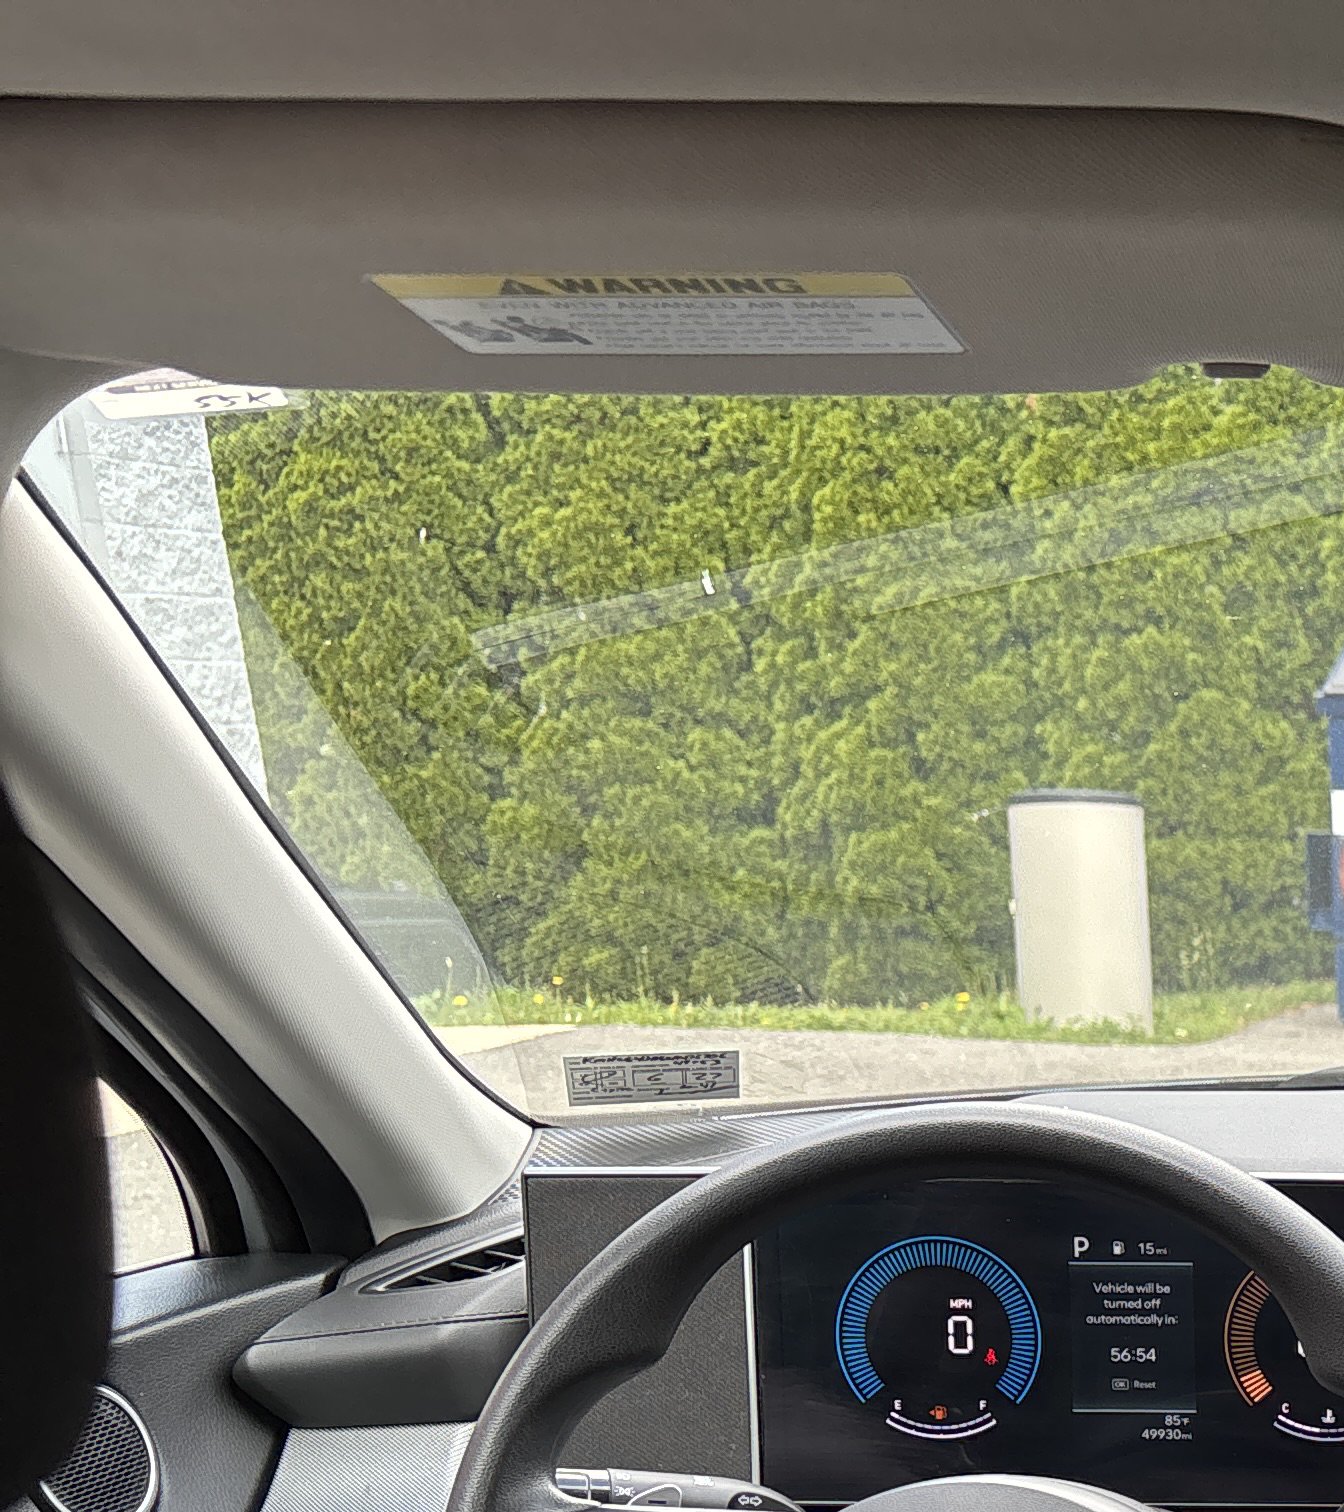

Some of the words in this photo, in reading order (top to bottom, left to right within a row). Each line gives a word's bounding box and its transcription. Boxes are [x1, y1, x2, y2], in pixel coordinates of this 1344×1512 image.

[547, 278, 807, 294] WARNING
[1073, 1236, 1090, 1258] P
[1093, 1282, 1134, 1294] Vehicle
[1136, 1282, 1154, 1294] will
[1156, 1283, 1170, 1294] be
[949, 1299, 972, 1309] MPH
[1104, 1299, 1142, 1310] turned
[1144, 1299, 1160, 1310] off
[1086, 1313, 1163, 1327] automatically
[1164, 1314, 1178, 1325] in:
[947, 1315, 974, 1354] 0
[1110, 1347, 1156, 1363] 56:54
[1134, 1380, 1156, 1389] Reset
[893, 1399, 902, 1410] E
[979, 1399, 987, 1410] F
[1281, 1402, 1290, 1413] C
